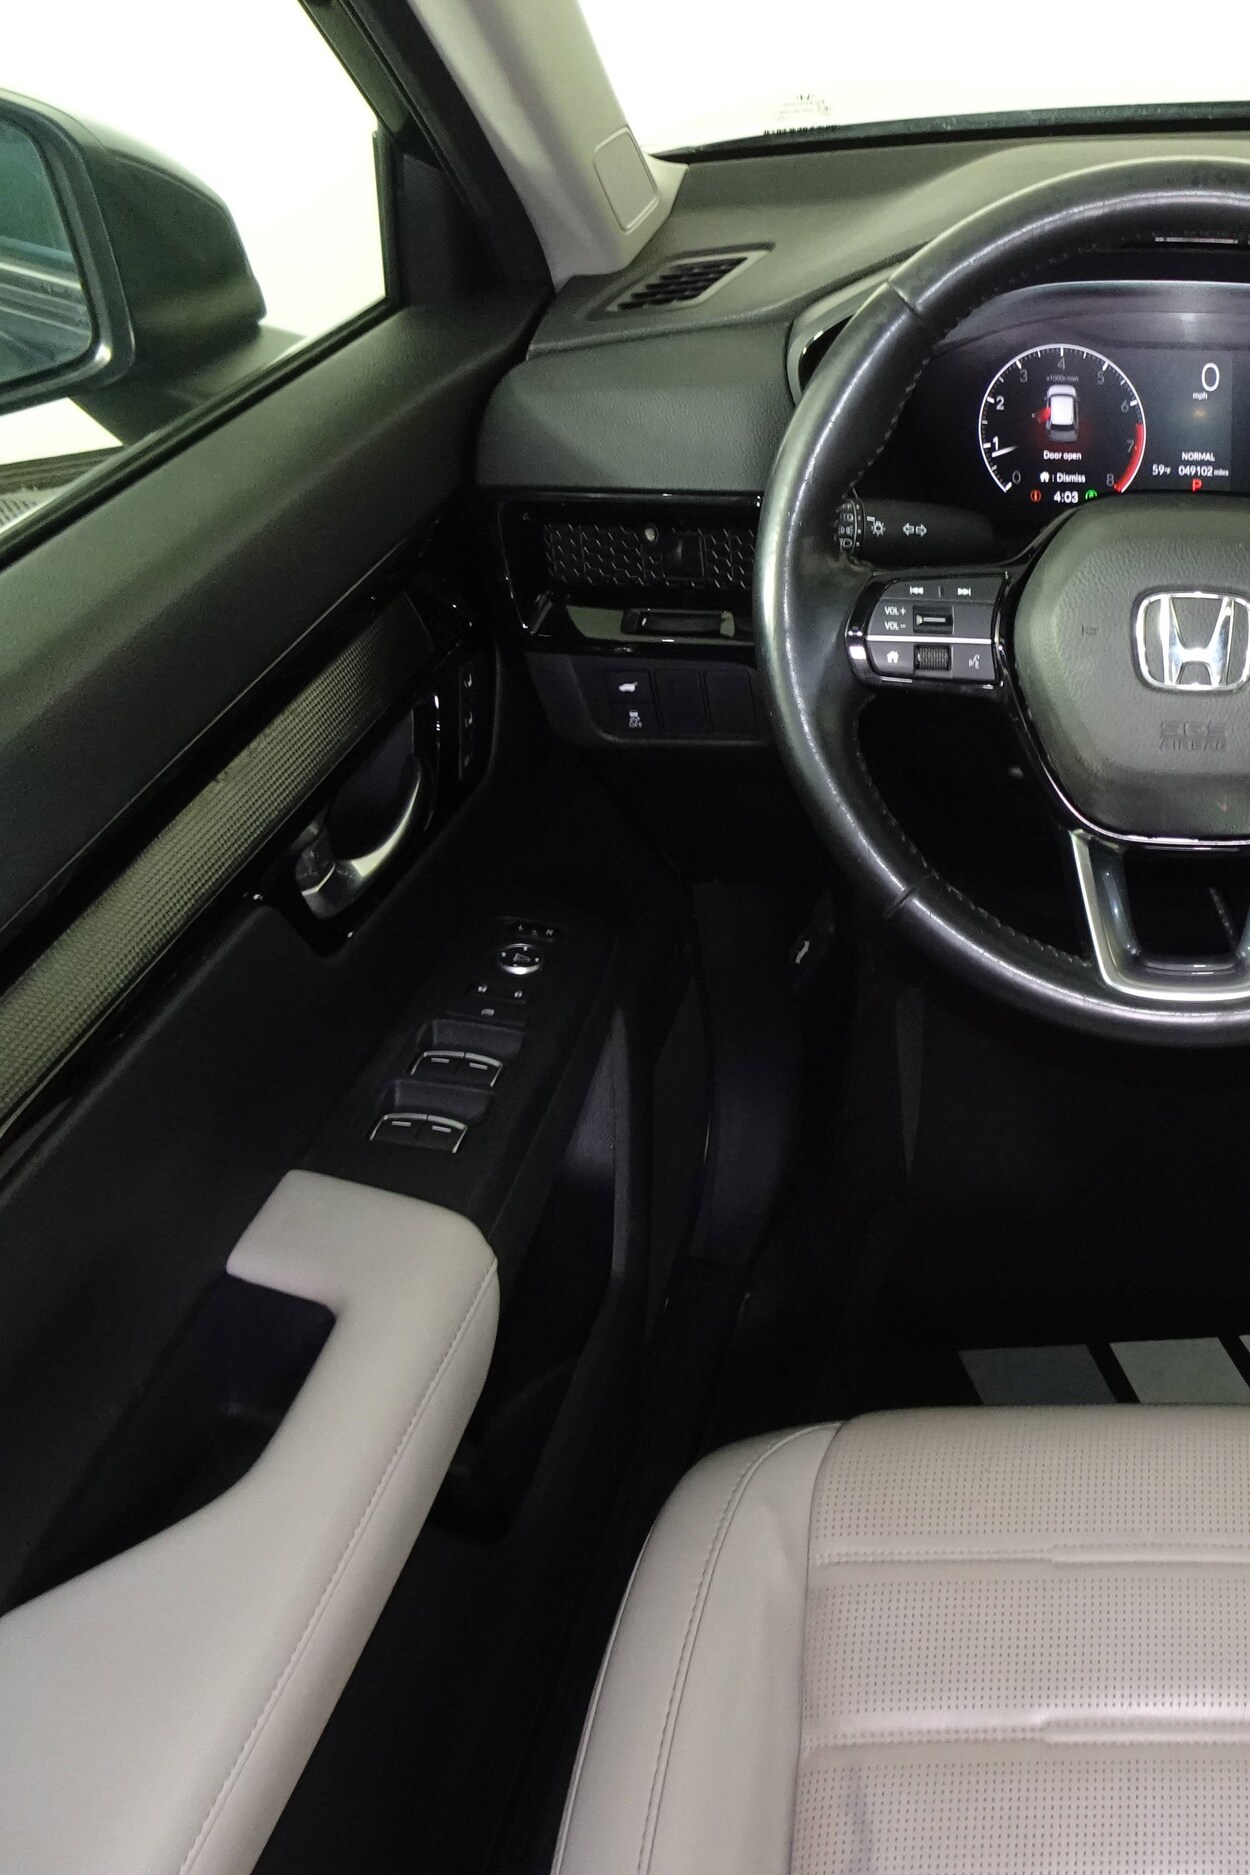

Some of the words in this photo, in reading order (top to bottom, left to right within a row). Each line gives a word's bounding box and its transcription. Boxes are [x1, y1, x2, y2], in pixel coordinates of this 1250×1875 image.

[1057, 358, 1066, 370] 4
[1020, 369, 1028, 382] 3
[1097, 371, 1105, 384] 5
[1201, 362, 1220, 391] 0
[1192, 391, 1208, 400] mph
[996, 398, 1004, 410] 2
[1121, 400, 1129, 412] 6
[992, 436, 999, 450] 1
[1043, 451, 1062, 461] Door
[1063, 452, 1082, 463] open
[1181, 451, 1215, 461] NORMAL
[1178, 464, 1213, 476] 049102
[1012, 470, 1021, 484] 0
[1056, 472, 1086, 483] Dismiss
[1106, 473, 1115, 486] 8
[1191, 478, 1202, 491] P
[1053, 490, 1079, 503] 4:03
[885, 606, 898, 616] VOL
[885, 622, 898, 631] VOL
